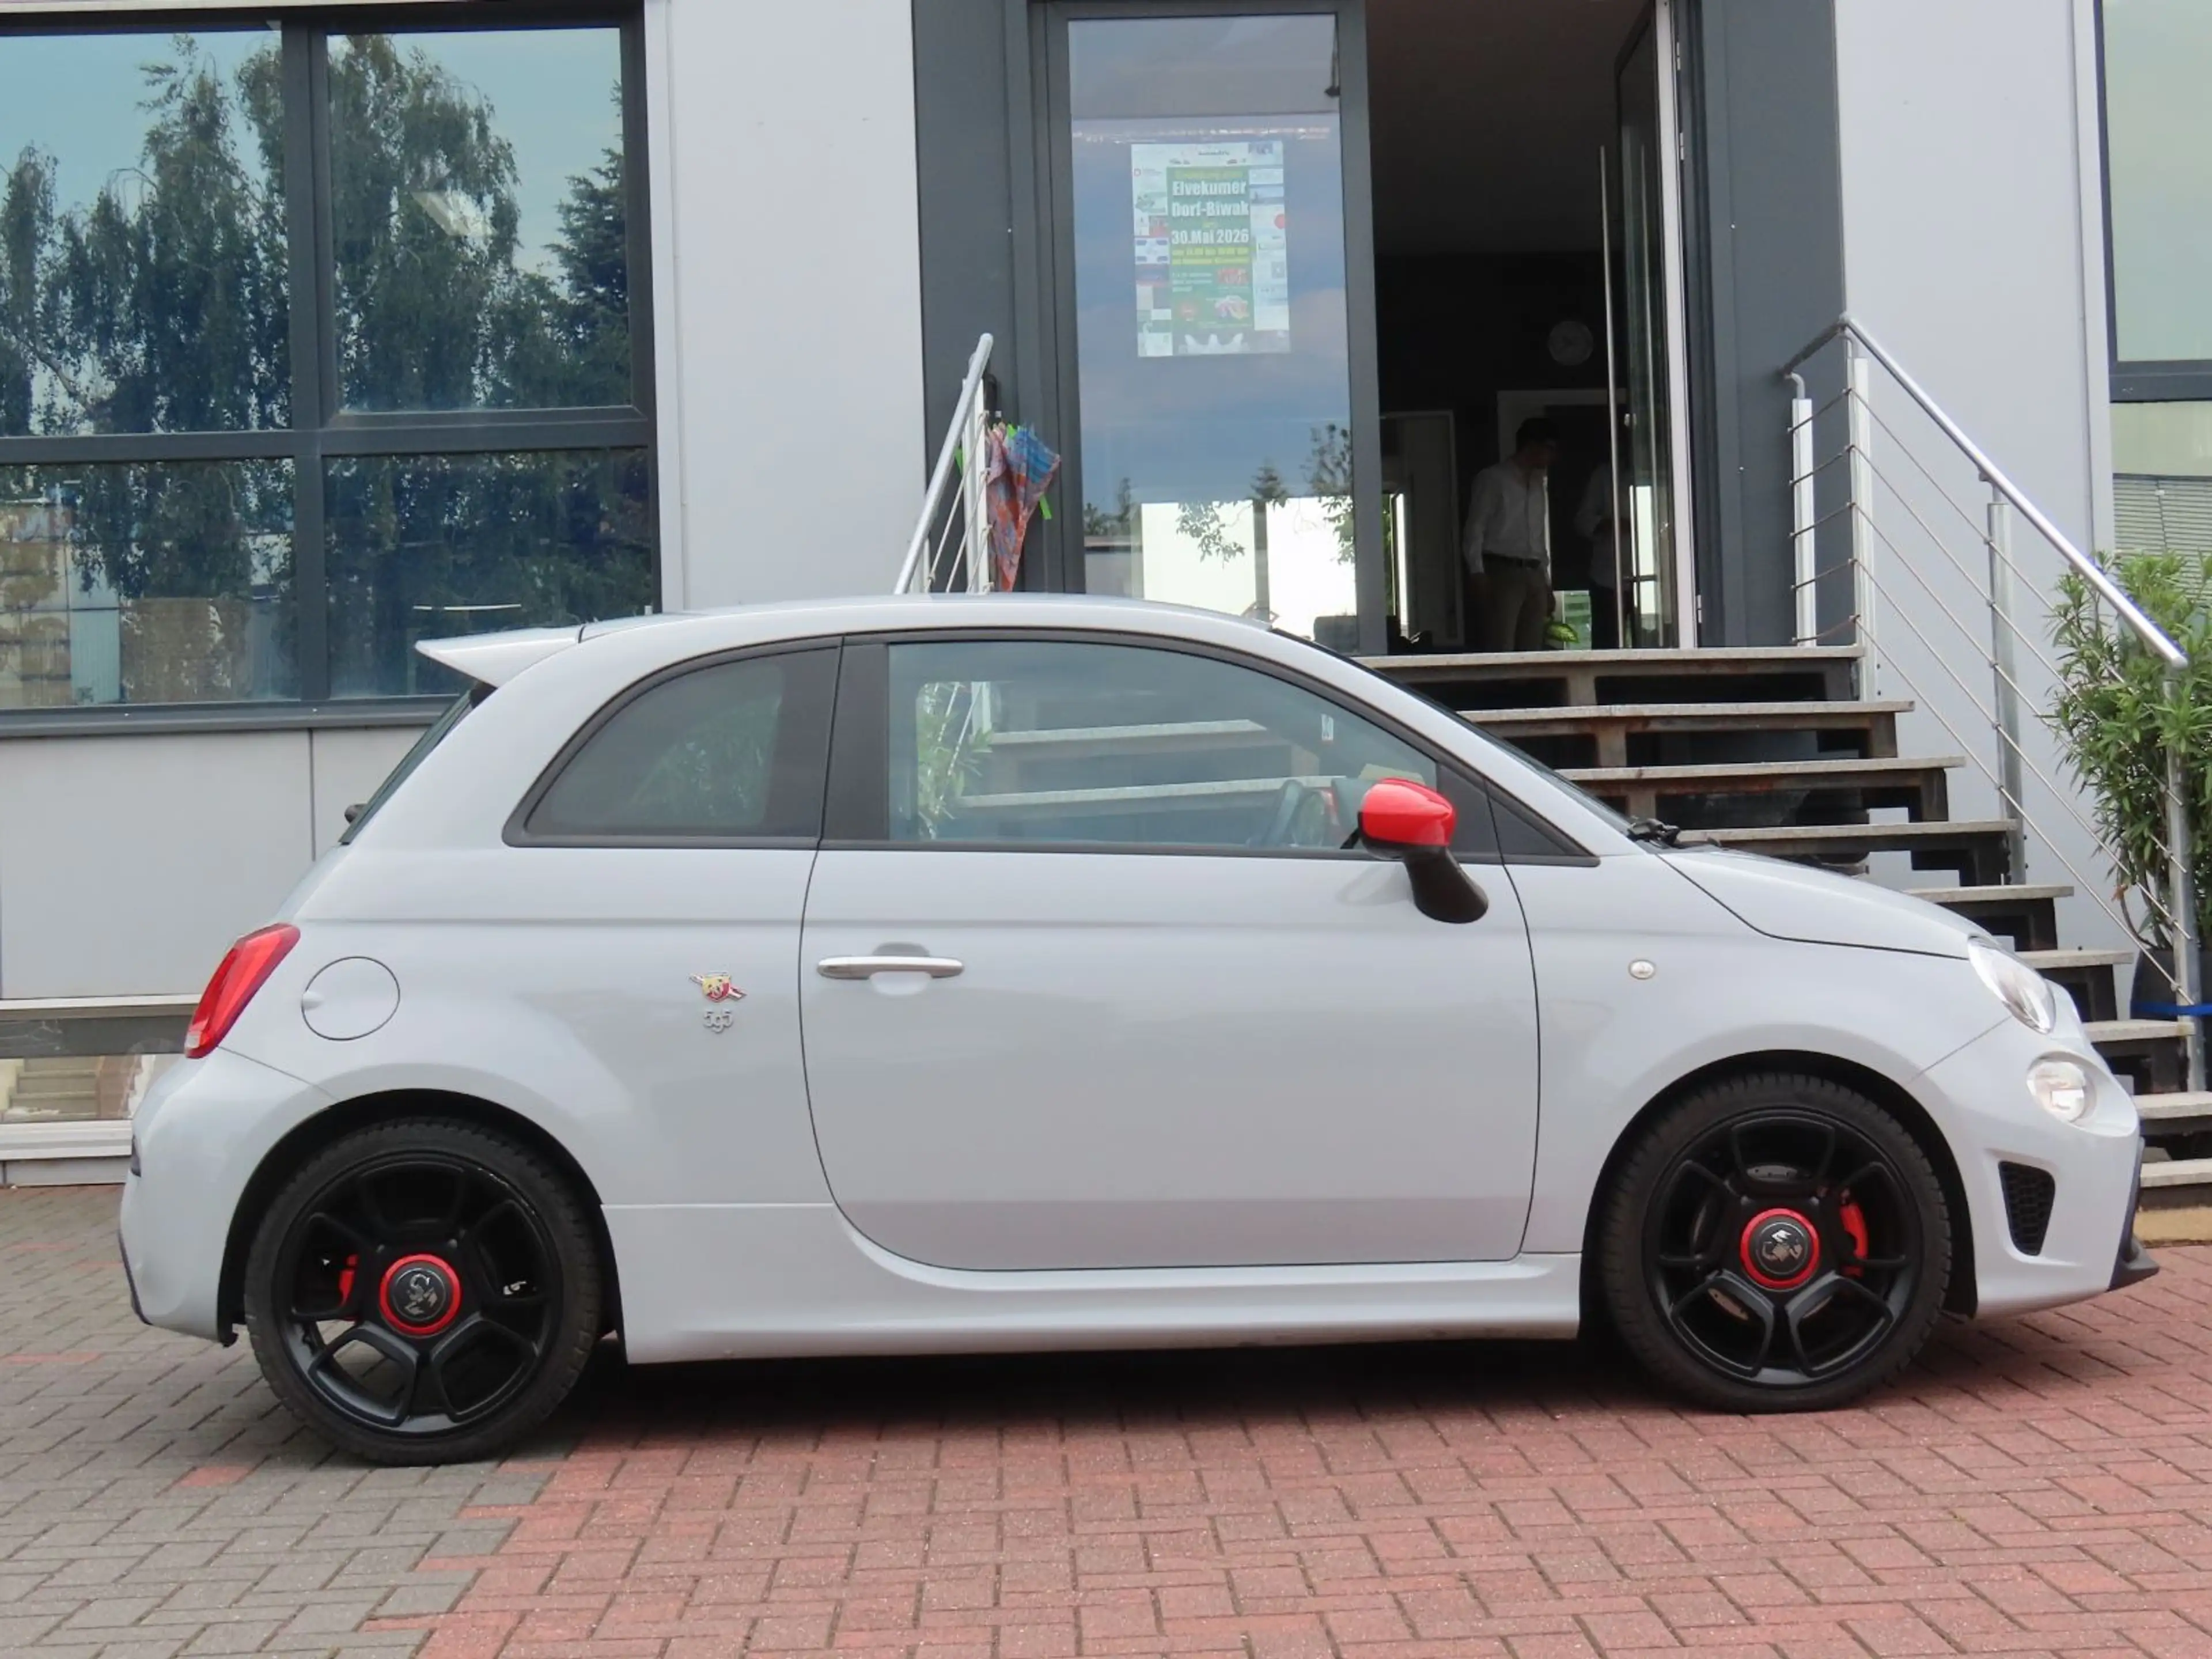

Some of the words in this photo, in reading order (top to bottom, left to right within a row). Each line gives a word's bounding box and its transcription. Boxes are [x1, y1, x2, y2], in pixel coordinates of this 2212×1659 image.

[1172, 180, 1246, 196] Elvekumer
[1172, 200, 1249, 217] Dorf-Biwak
[1217, 228, 1249, 243] 2026
[703, 1009, 734, 1035] 595
